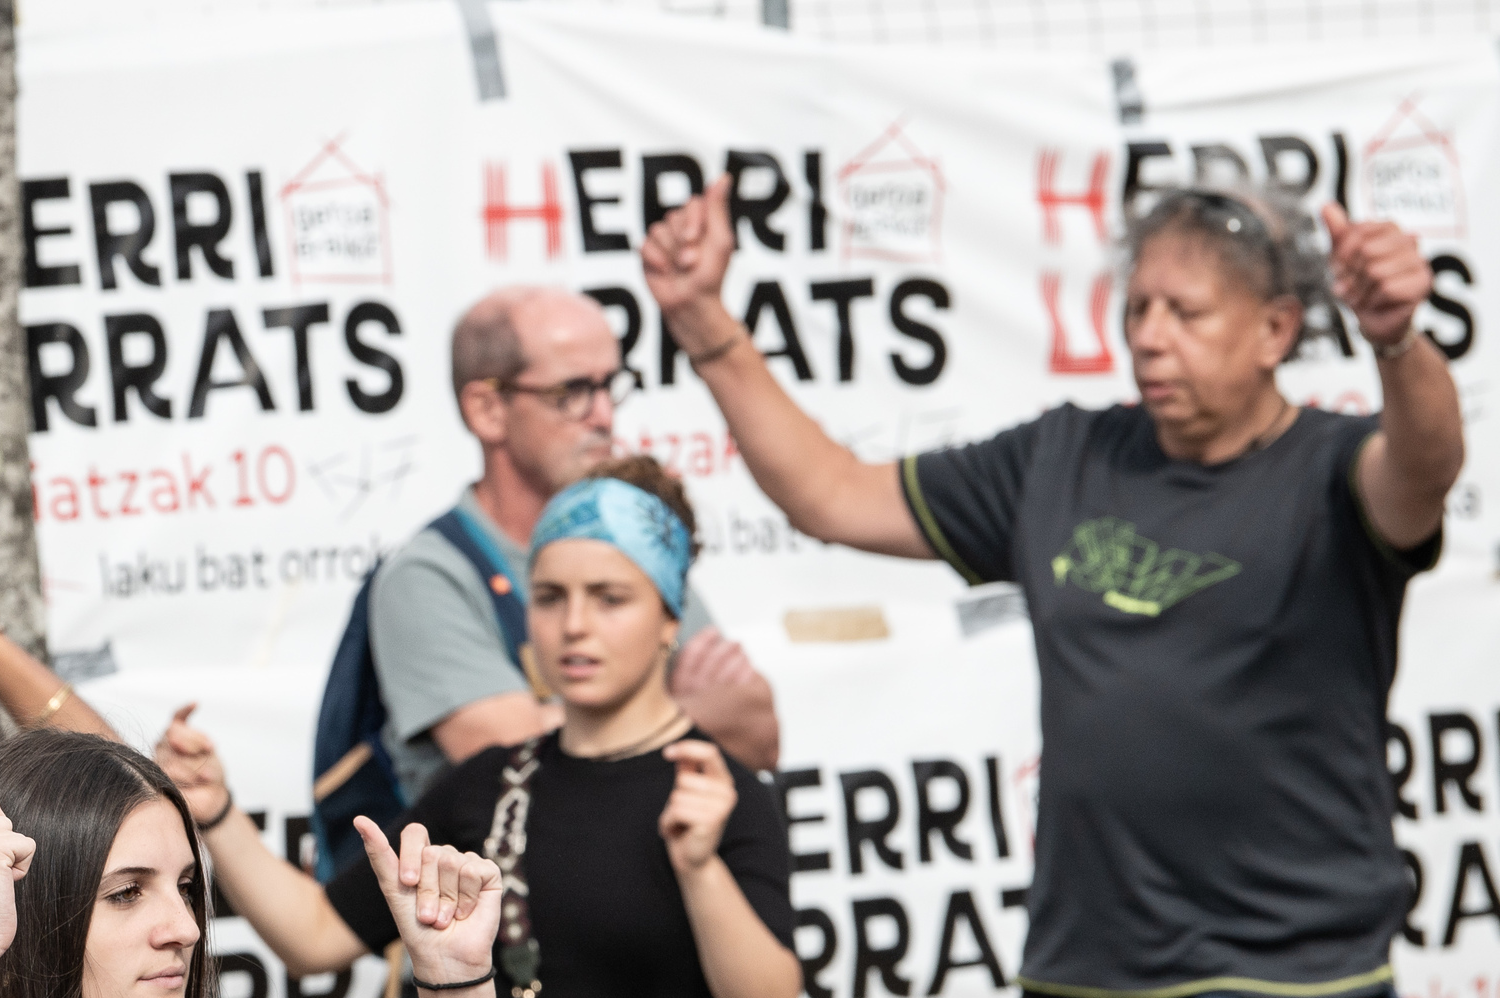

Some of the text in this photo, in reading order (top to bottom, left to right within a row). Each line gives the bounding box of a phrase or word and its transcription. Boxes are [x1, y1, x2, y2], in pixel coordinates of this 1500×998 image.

[21, 168, 276, 291] ERRI
[24, 300, 406, 433] RRATS
[229, 443, 298, 508] 10
[195, 543, 271, 592] bat
[780, 755, 1012, 877] ERRI
